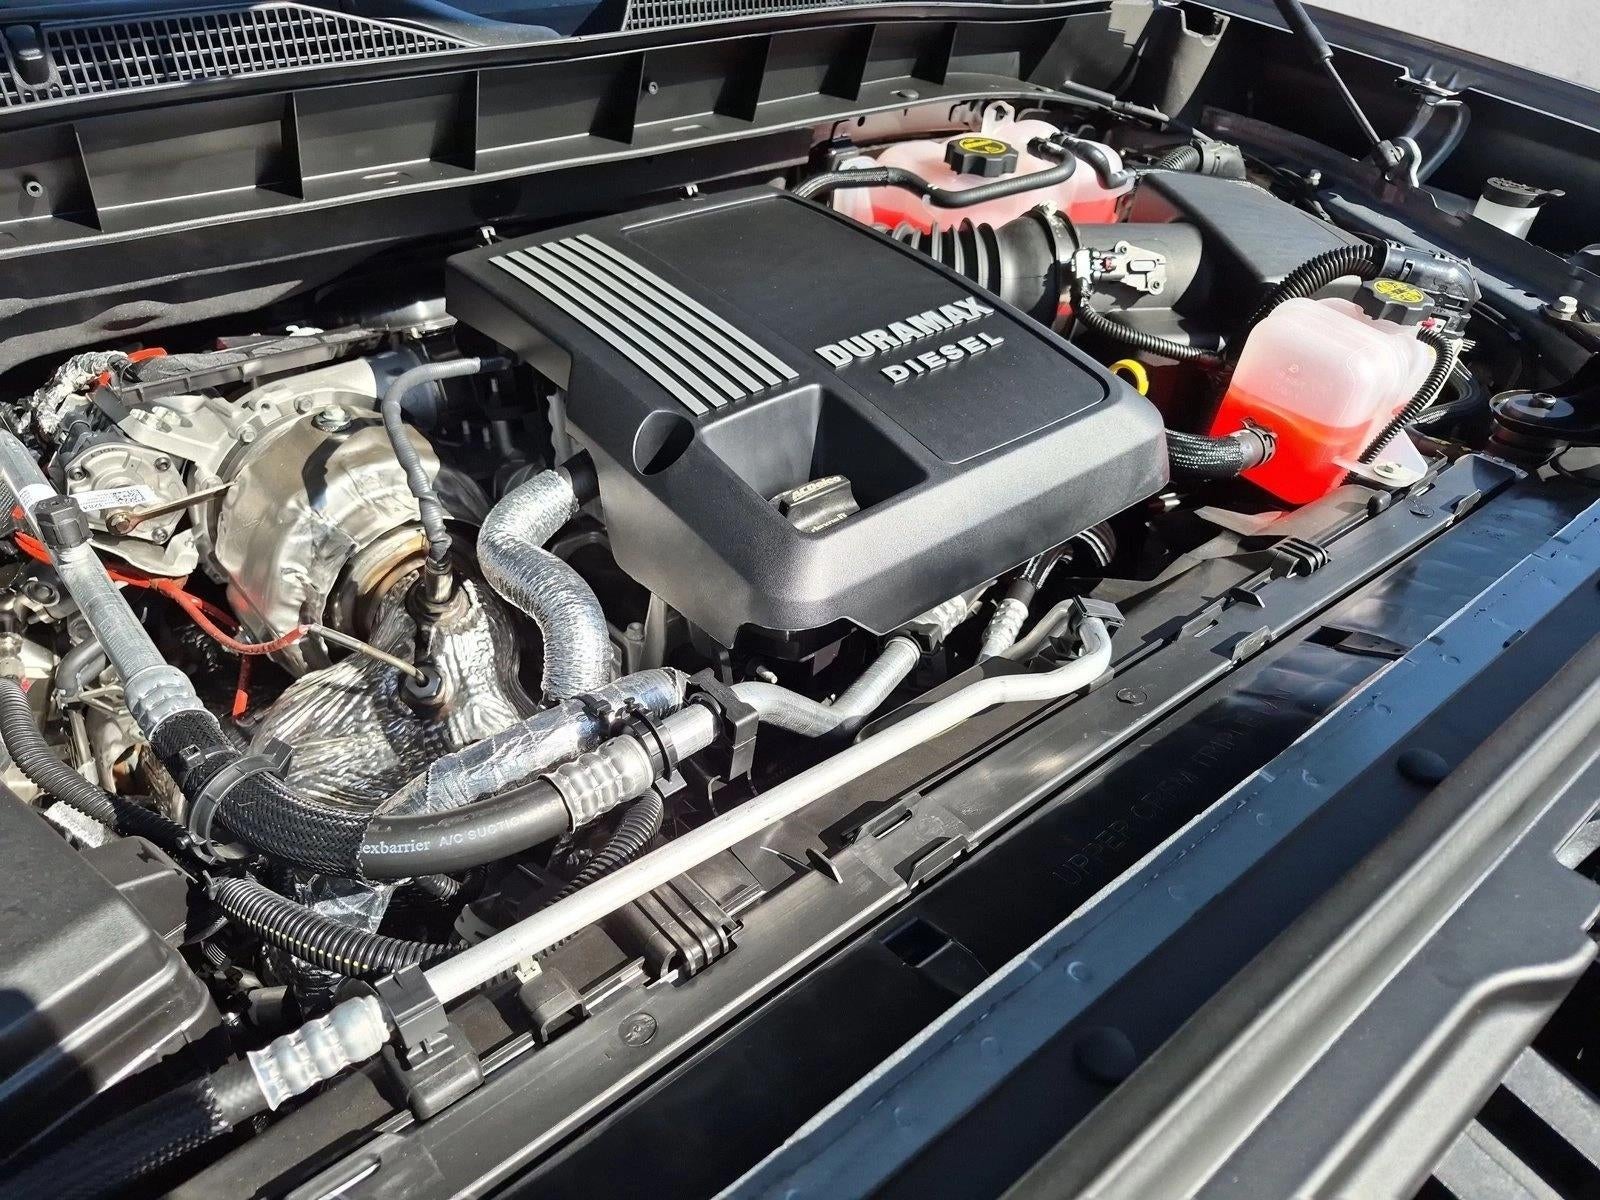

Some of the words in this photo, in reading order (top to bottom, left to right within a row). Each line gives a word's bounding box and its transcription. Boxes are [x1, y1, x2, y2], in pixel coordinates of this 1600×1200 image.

[815, 296, 995, 368] DURAMAX
[880, 332, 1005, 384] DIESEL
[362, 839, 431, 854] exbarrier
[439, 833, 464, 847] A/C
